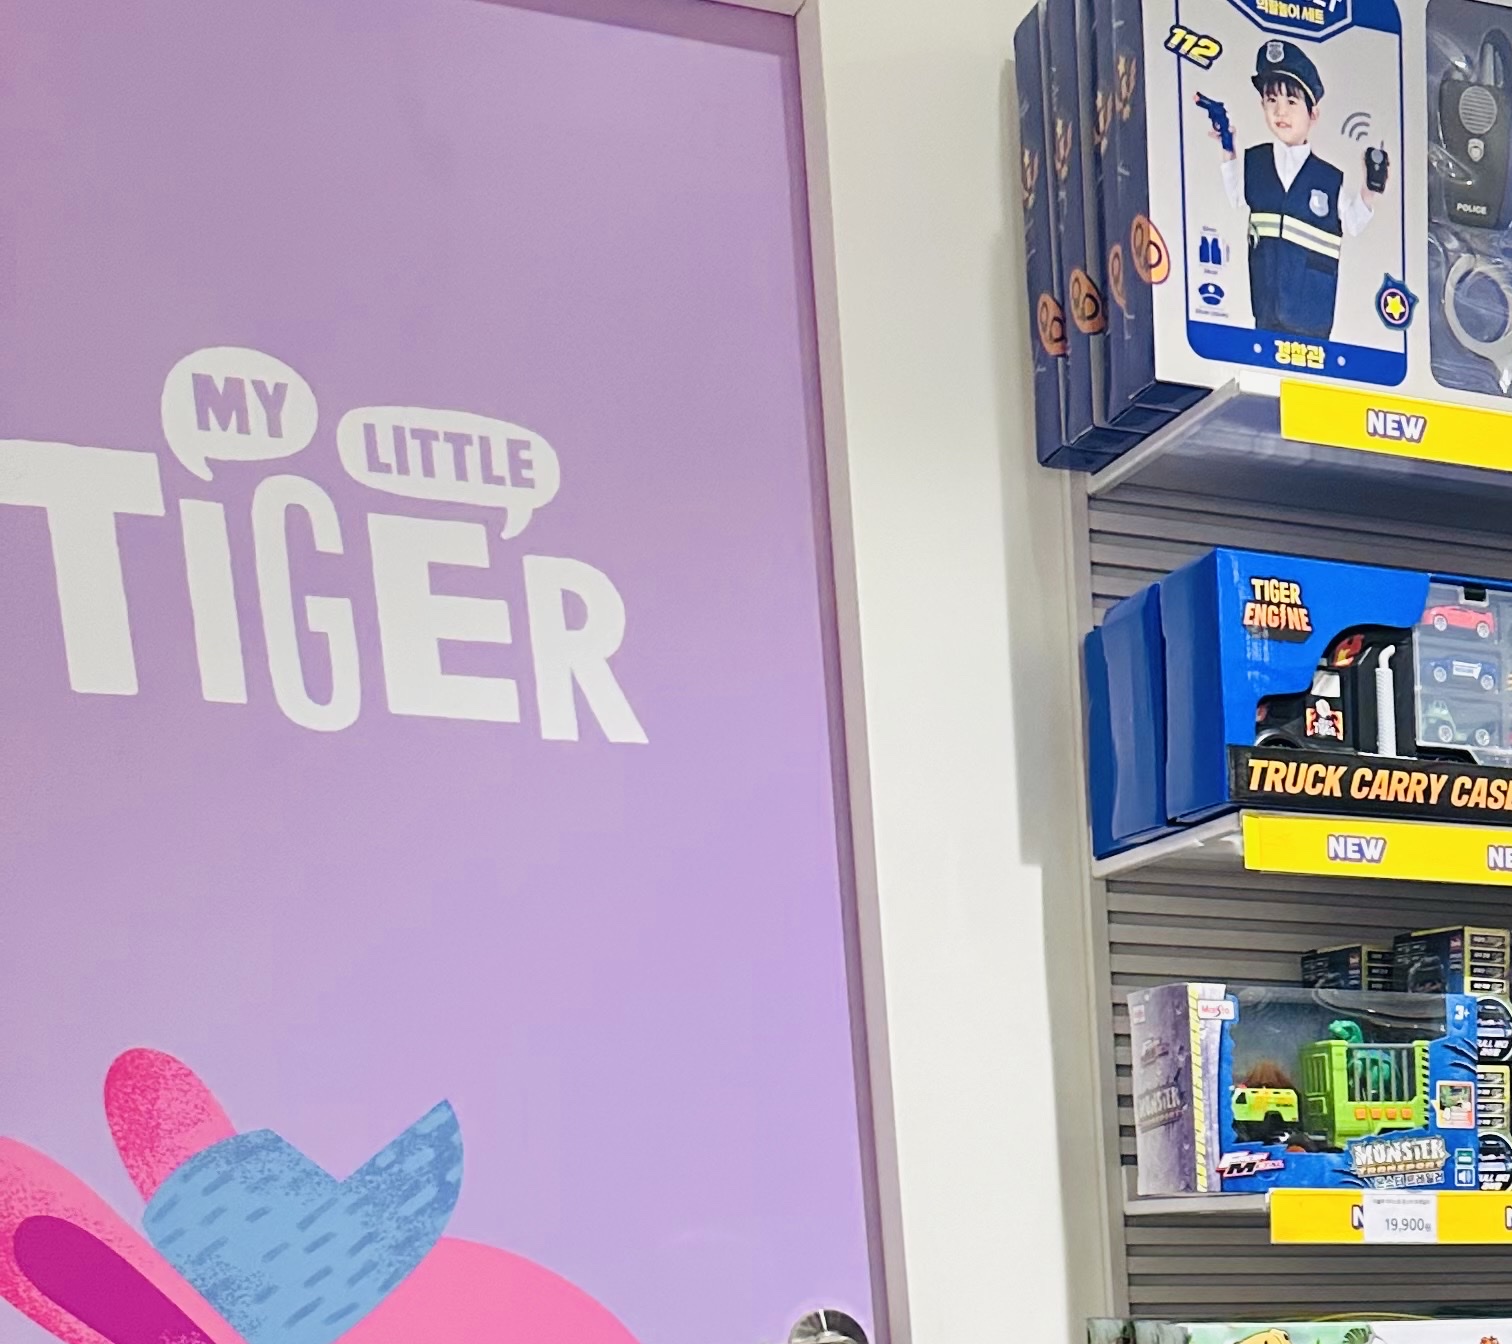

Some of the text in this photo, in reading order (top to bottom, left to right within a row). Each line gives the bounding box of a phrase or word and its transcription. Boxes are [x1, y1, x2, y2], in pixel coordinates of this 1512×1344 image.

[1168, 27, 1222, 66] 112
[1456, 202, 1487, 217] POLICE
[1273, 338, 1326, 371] 경찰관
[192, 373, 289, 439] MY
[1366, 408, 1427, 443] NEW
[362, 423, 537, 489] LITTLE
[0, 438, 650, 745] TIGER
[1250, 577, 1302, 606] TIGER
[1242, 602, 1313, 634] ENGINE
[1248, 758, 1343, 798] TRUCK
[1350, 772, 1444, 806] CARRY
[1327, 834, 1388, 864] NEW
[1454, 1004, 1470, 1020] 3+
[1352, 1136, 1447, 1167] MONSTER
[1384, 1216, 1432, 1234] 19,900원
